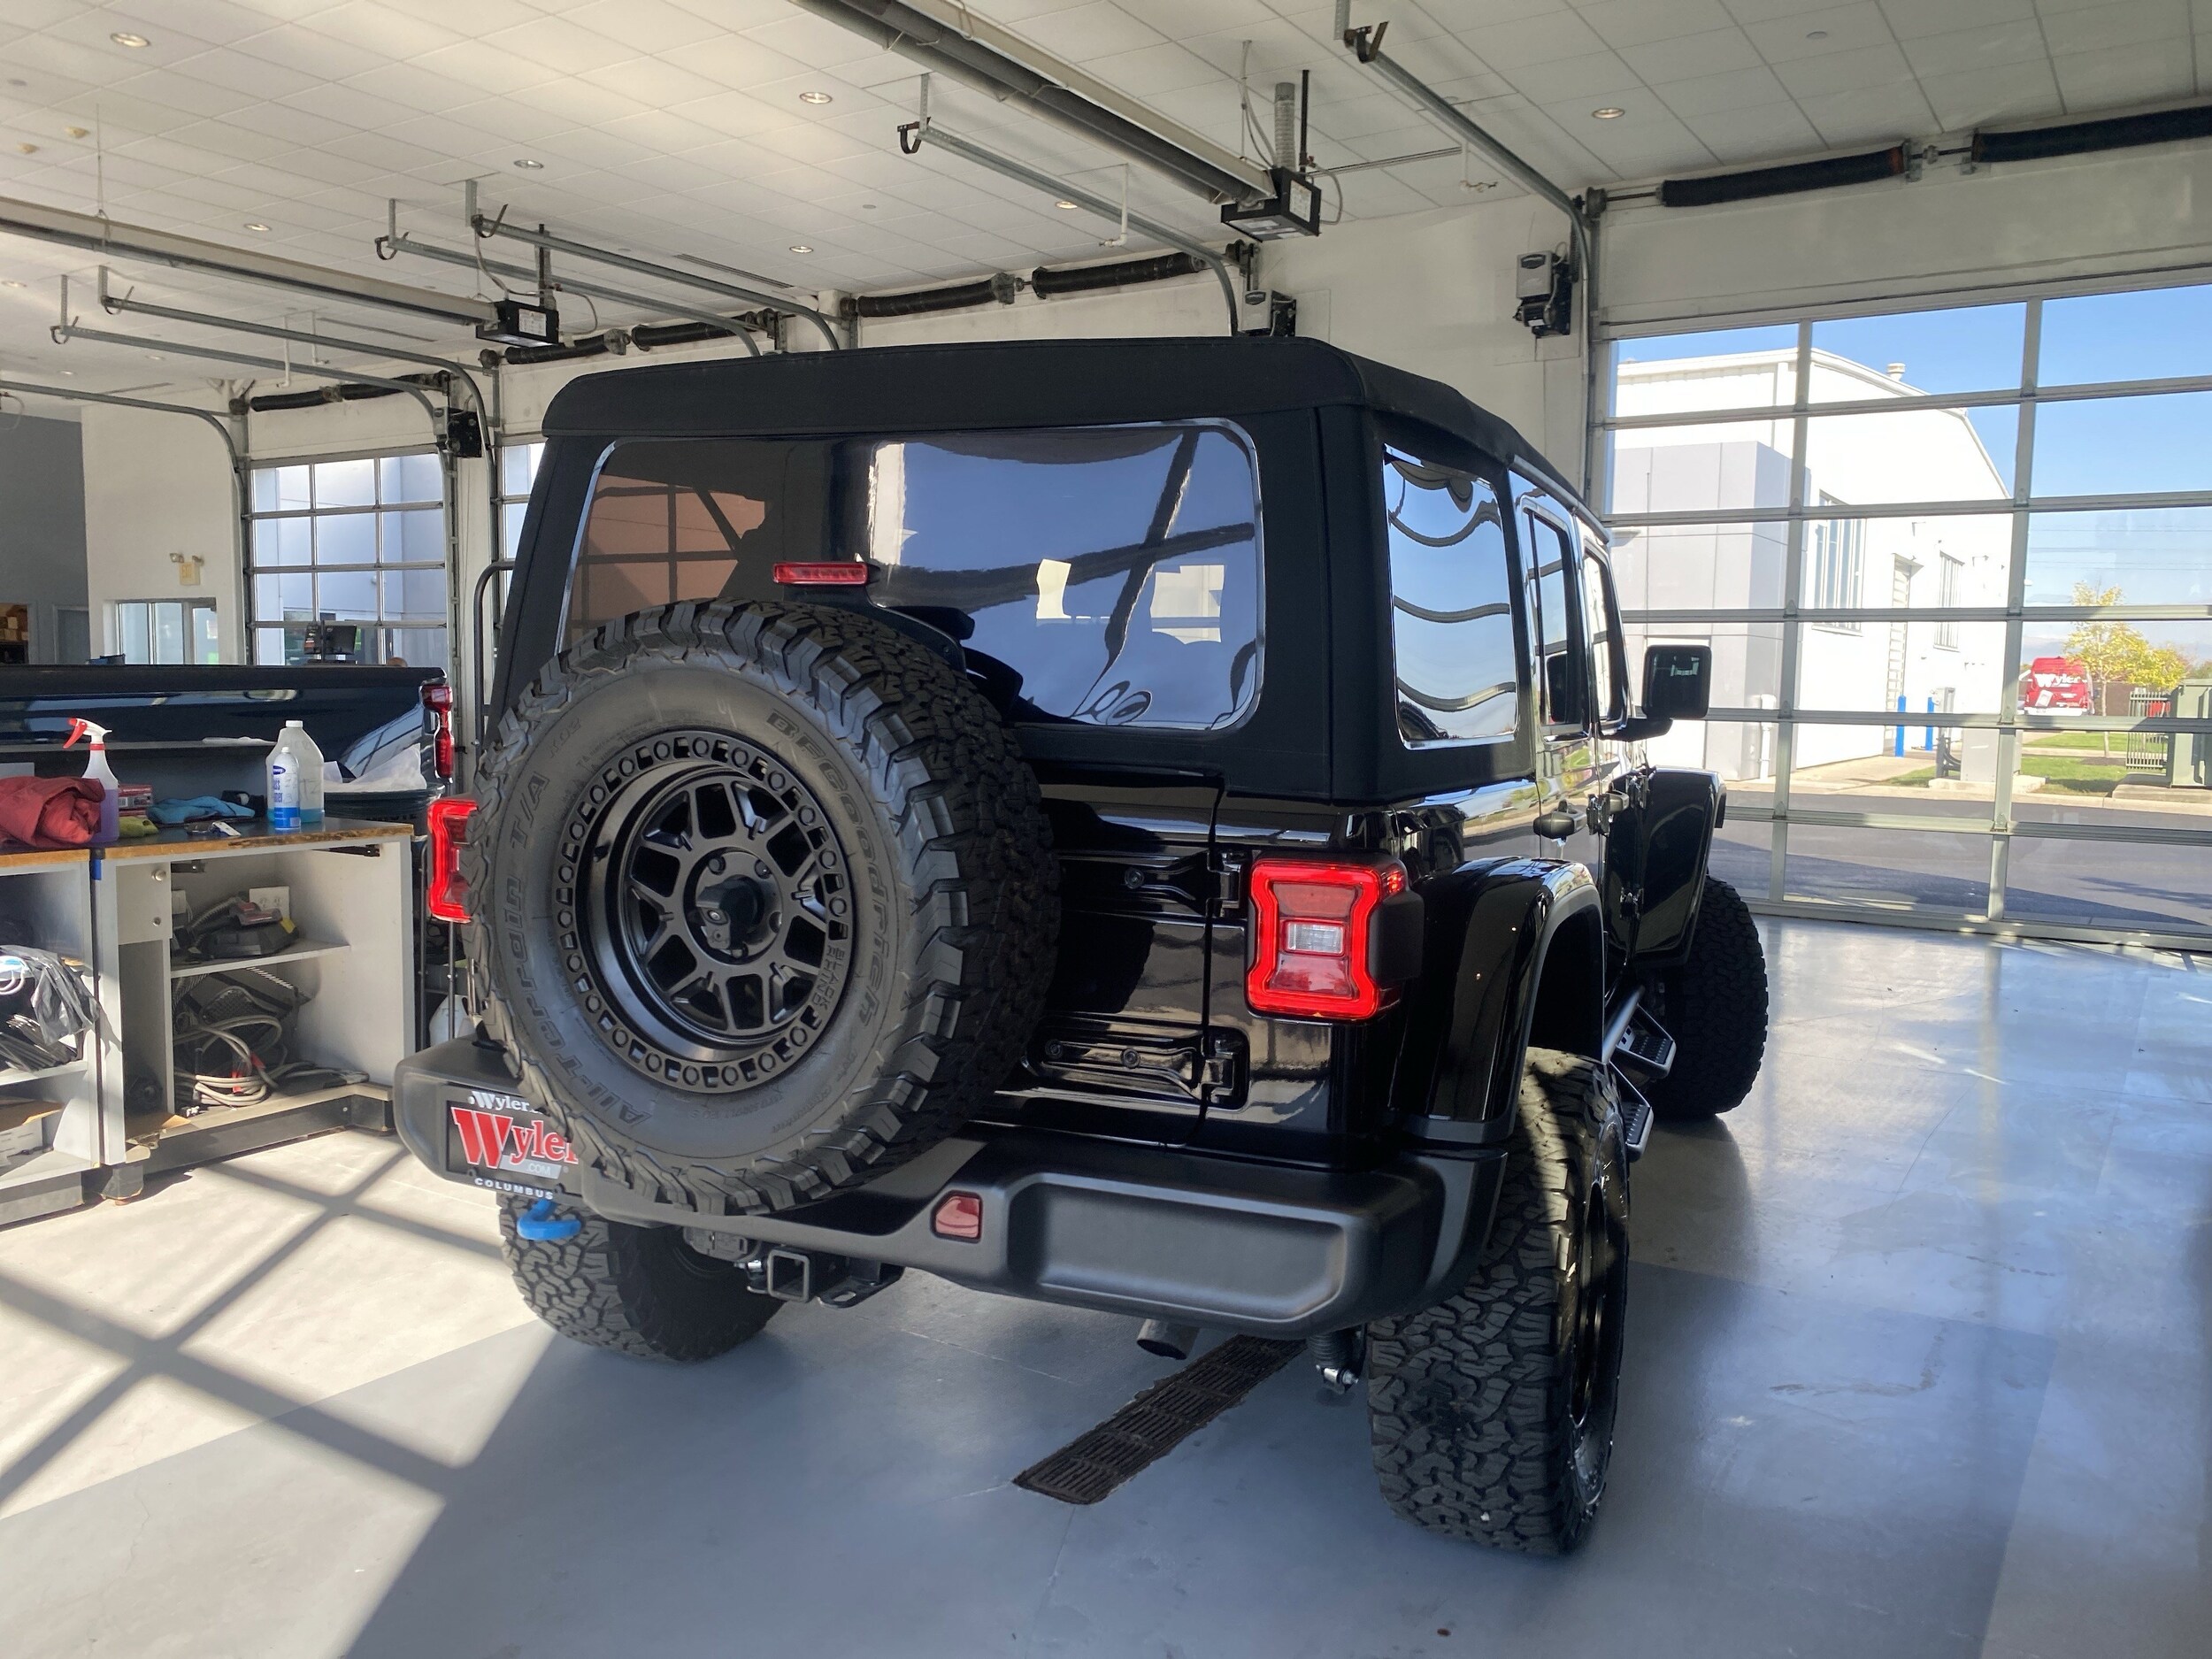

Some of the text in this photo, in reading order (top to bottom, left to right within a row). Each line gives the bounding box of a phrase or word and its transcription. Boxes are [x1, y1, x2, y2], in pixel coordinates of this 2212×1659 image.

[2034, 673, 2081, 687] Wyler
[765, 711, 888, 1026] BFGoodrich
[819, 948, 845, 1010] BLACK
[472, 1091, 529, 1111] Wyler
[474, 1178, 554, 1200] COLUMBUS
